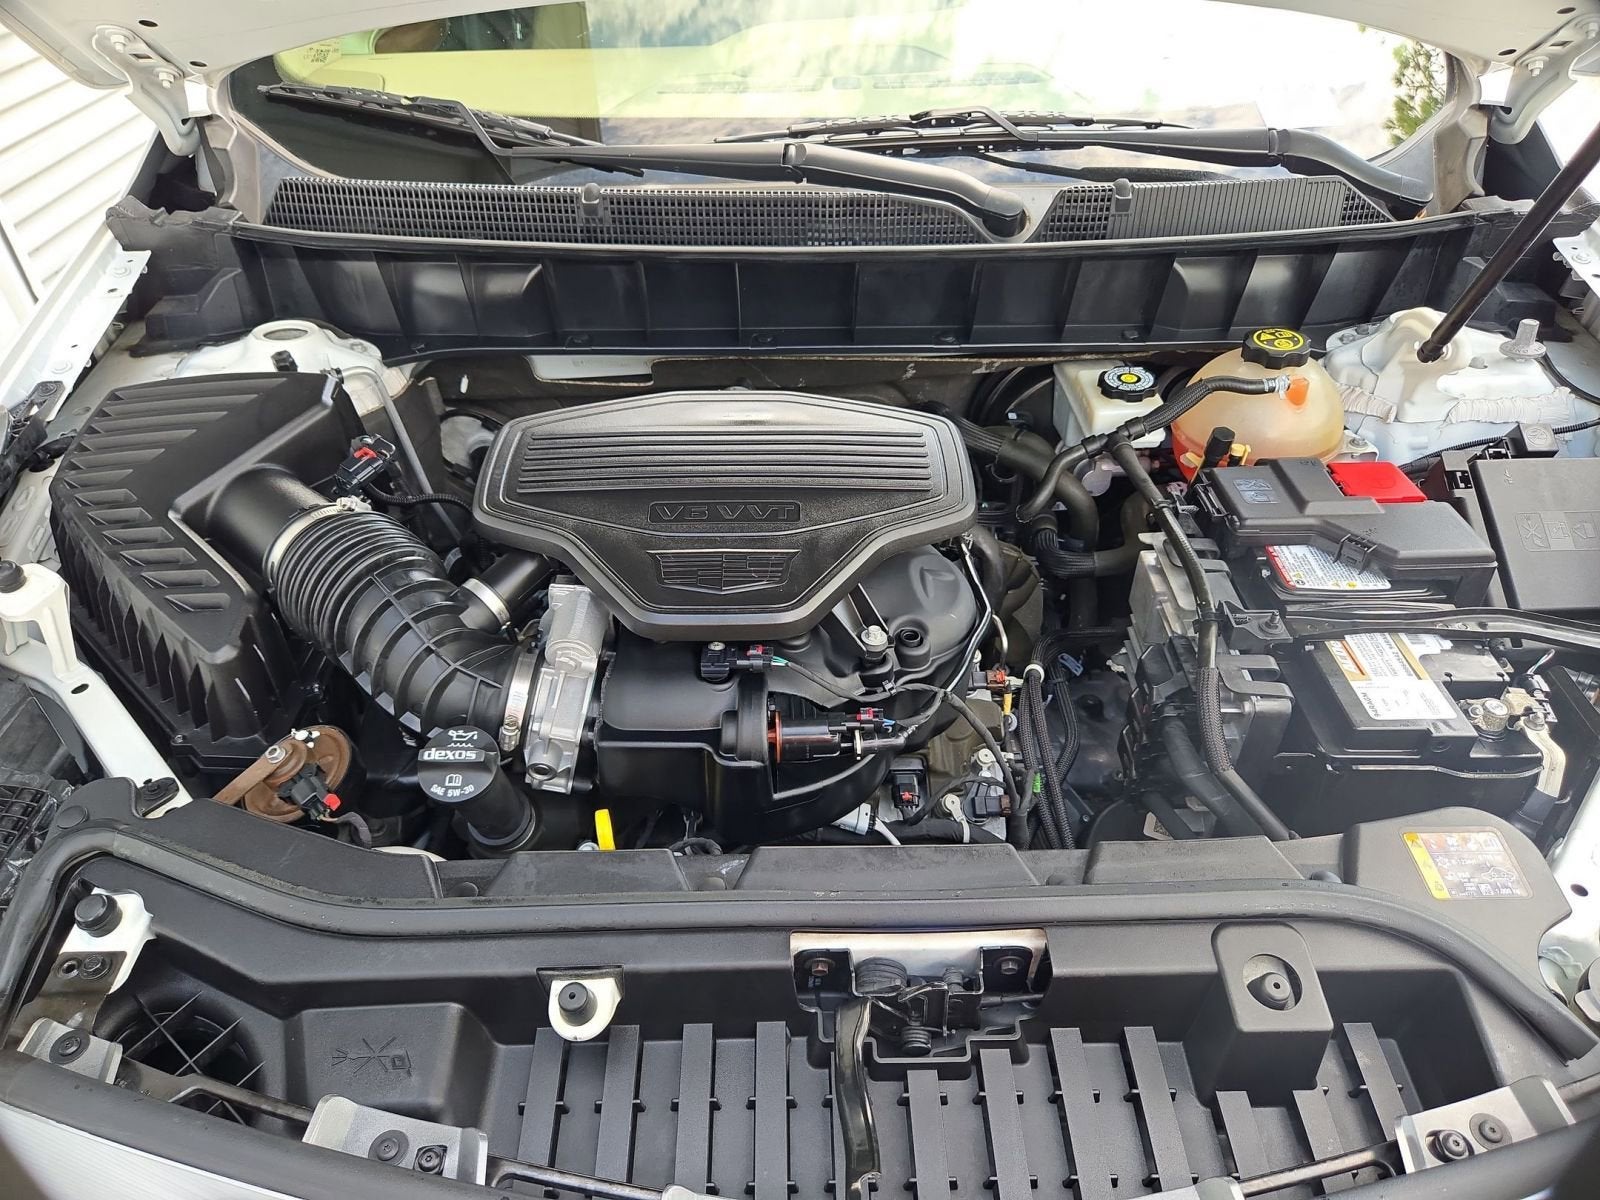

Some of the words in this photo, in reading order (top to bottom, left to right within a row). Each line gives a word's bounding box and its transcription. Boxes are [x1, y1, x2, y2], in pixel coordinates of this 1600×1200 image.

[716, 504, 795, 520] VVT
[423, 747, 477, 760] dexos
[430, 783, 446, 796] SAE
[447, 784, 475, 797] 5W-30
